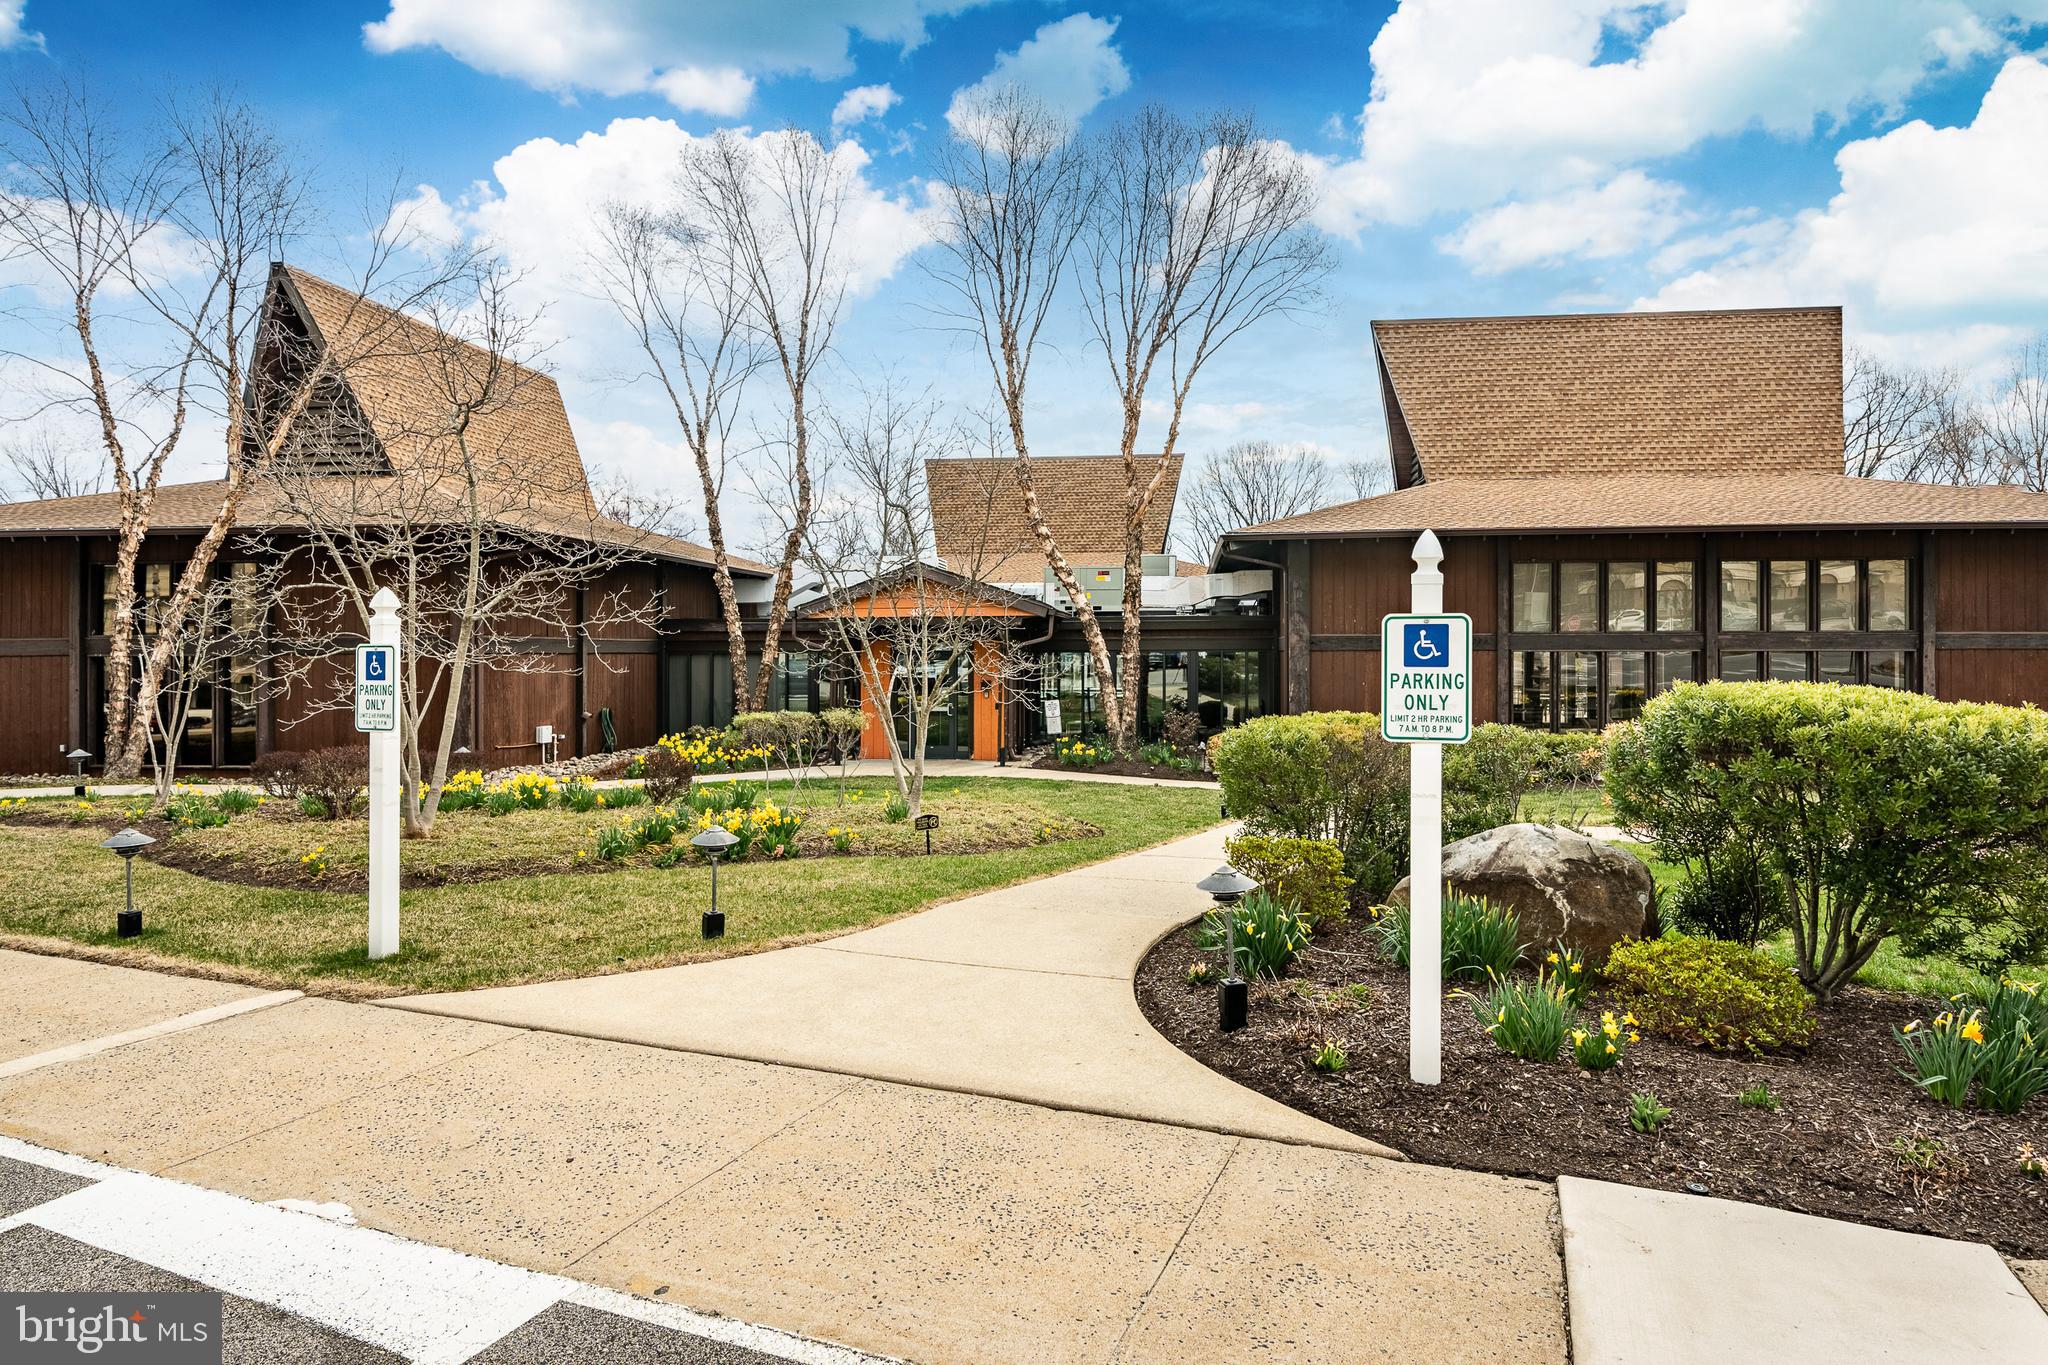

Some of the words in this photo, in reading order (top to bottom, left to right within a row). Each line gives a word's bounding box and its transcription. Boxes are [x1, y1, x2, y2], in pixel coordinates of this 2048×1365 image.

[1390, 673, 1464, 689] PARKING
[360, 684, 392, 696] PARKING
[365, 699, 386, 710] ONLY
[1404, 694, 1449, 711] ONLY
[1390, 714, 1409, 722] LIMIT
[1411, 714, 1416, 722] 2
[1418, 715, 1428, 723] HR
[1430, 715, 1463, 723] PARKING
[1399, 724, 1403, 732] 7
[1421, 725, 1430, 733] TO
[1432, 725, 1437, 733] 8
